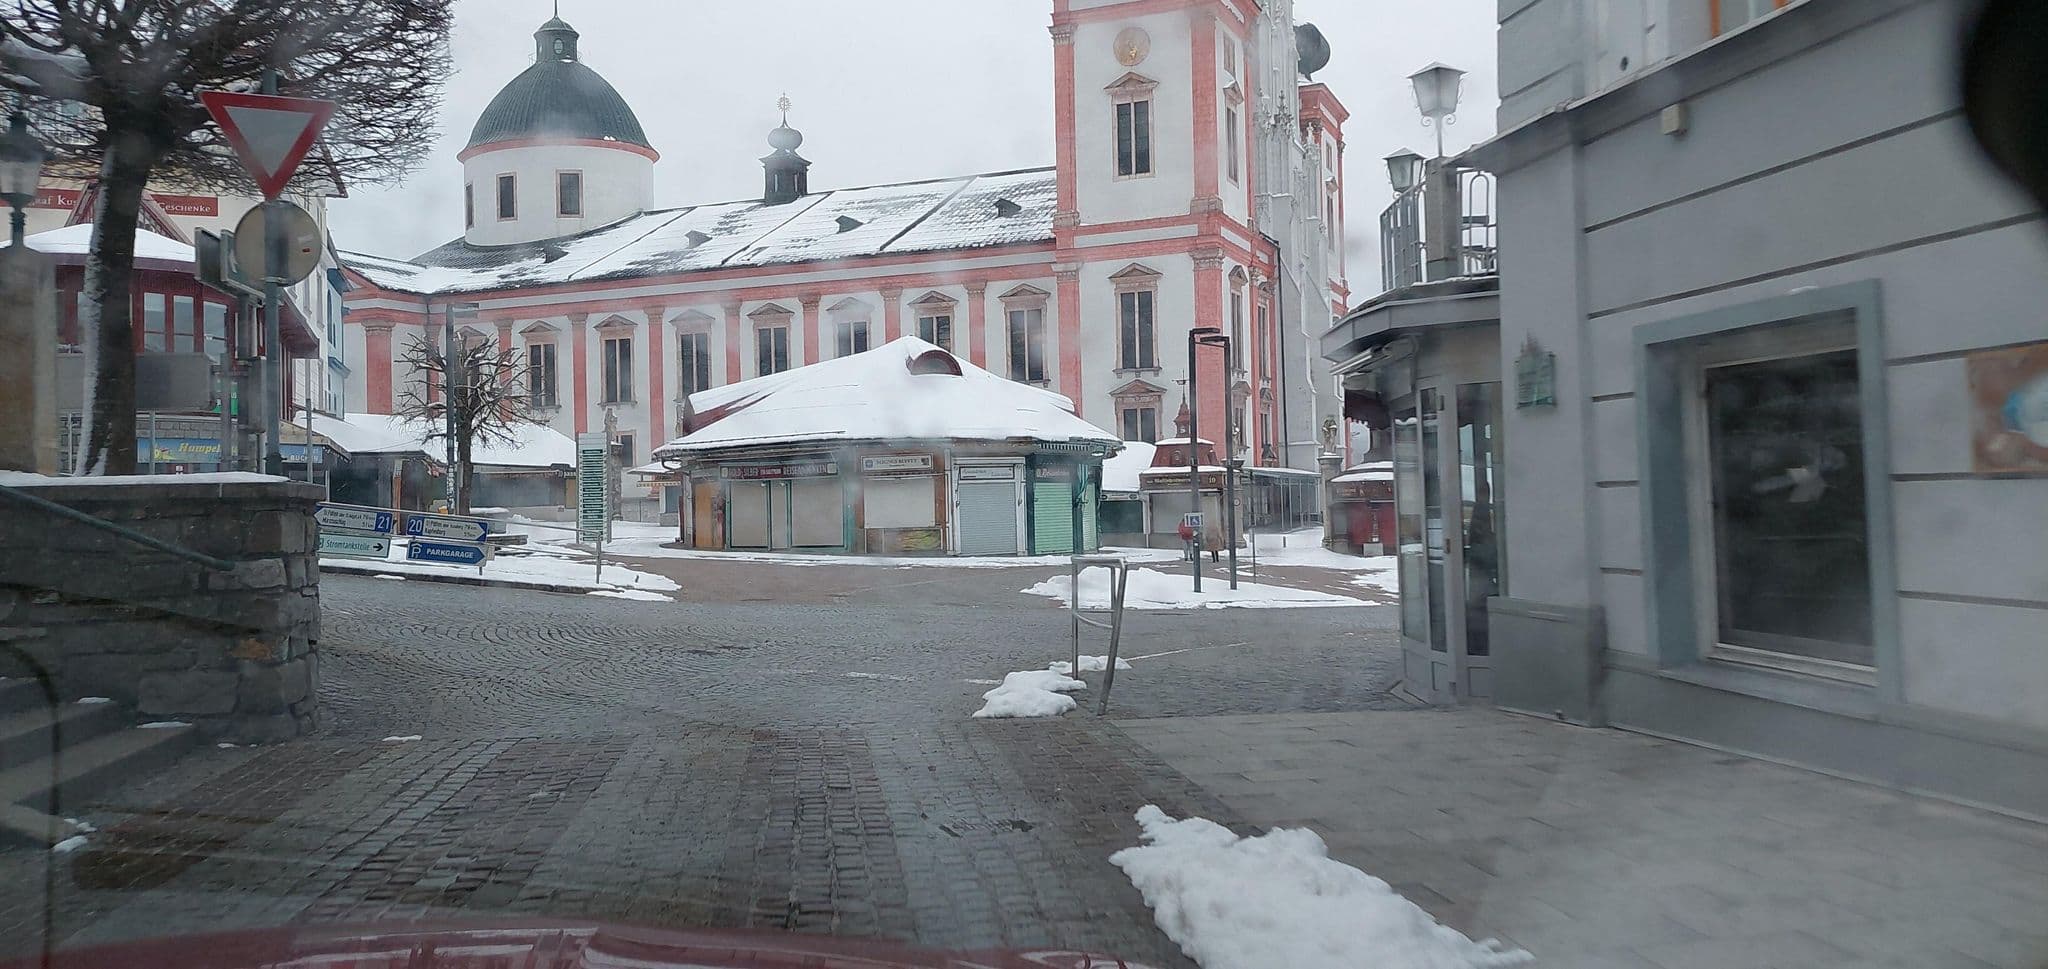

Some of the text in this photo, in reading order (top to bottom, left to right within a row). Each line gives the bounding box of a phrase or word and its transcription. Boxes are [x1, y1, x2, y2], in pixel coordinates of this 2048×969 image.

[377, 516, 390, 530] 21
[409, 518, 423, 533] 20
[326, 539, 370, 551] Stromtankstelle
[426, 548, 474, 559] PARKGARAGE
